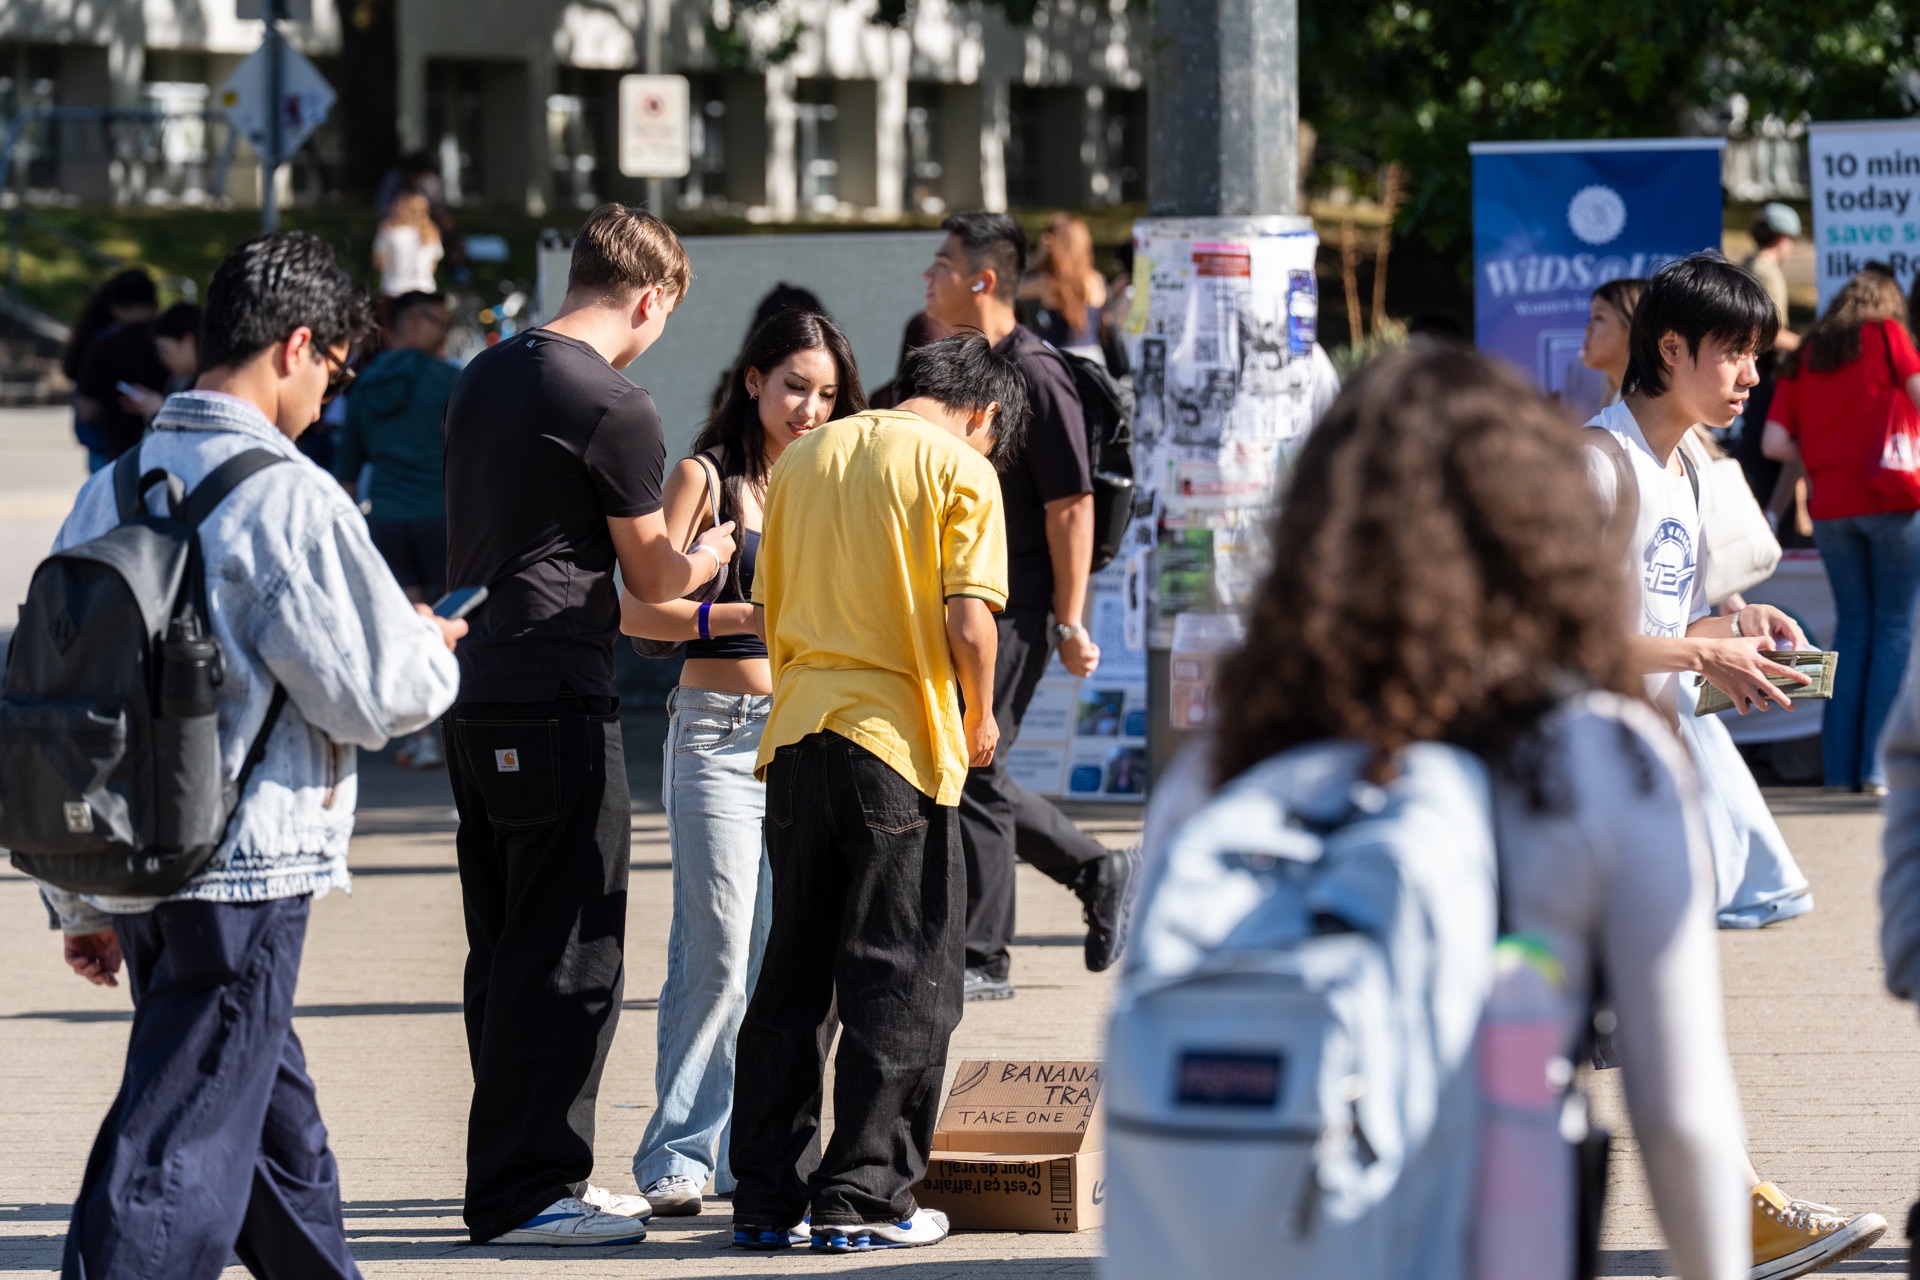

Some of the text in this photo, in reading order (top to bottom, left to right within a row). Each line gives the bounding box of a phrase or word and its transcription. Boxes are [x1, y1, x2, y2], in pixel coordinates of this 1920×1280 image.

[1823, 153, 1858, 177] 10
[1826, 185, 1910, 216] today
[1827, 222, 1893, 246] save
[1827, 252, 1876, 279] lik
[1000, 1063, 1101, 1083] BANANA
[1044, 1085, 1091, 1105] TRA
[958, 1111, 1064, 1124] TAKE ONE
[980, 1163, 998, 1176] de
[1000, 1163, 1041, 1180] (Pour
[983, 1178, 1001, 1192] ça
[1004, 1180, 1041, 1196] C'est
